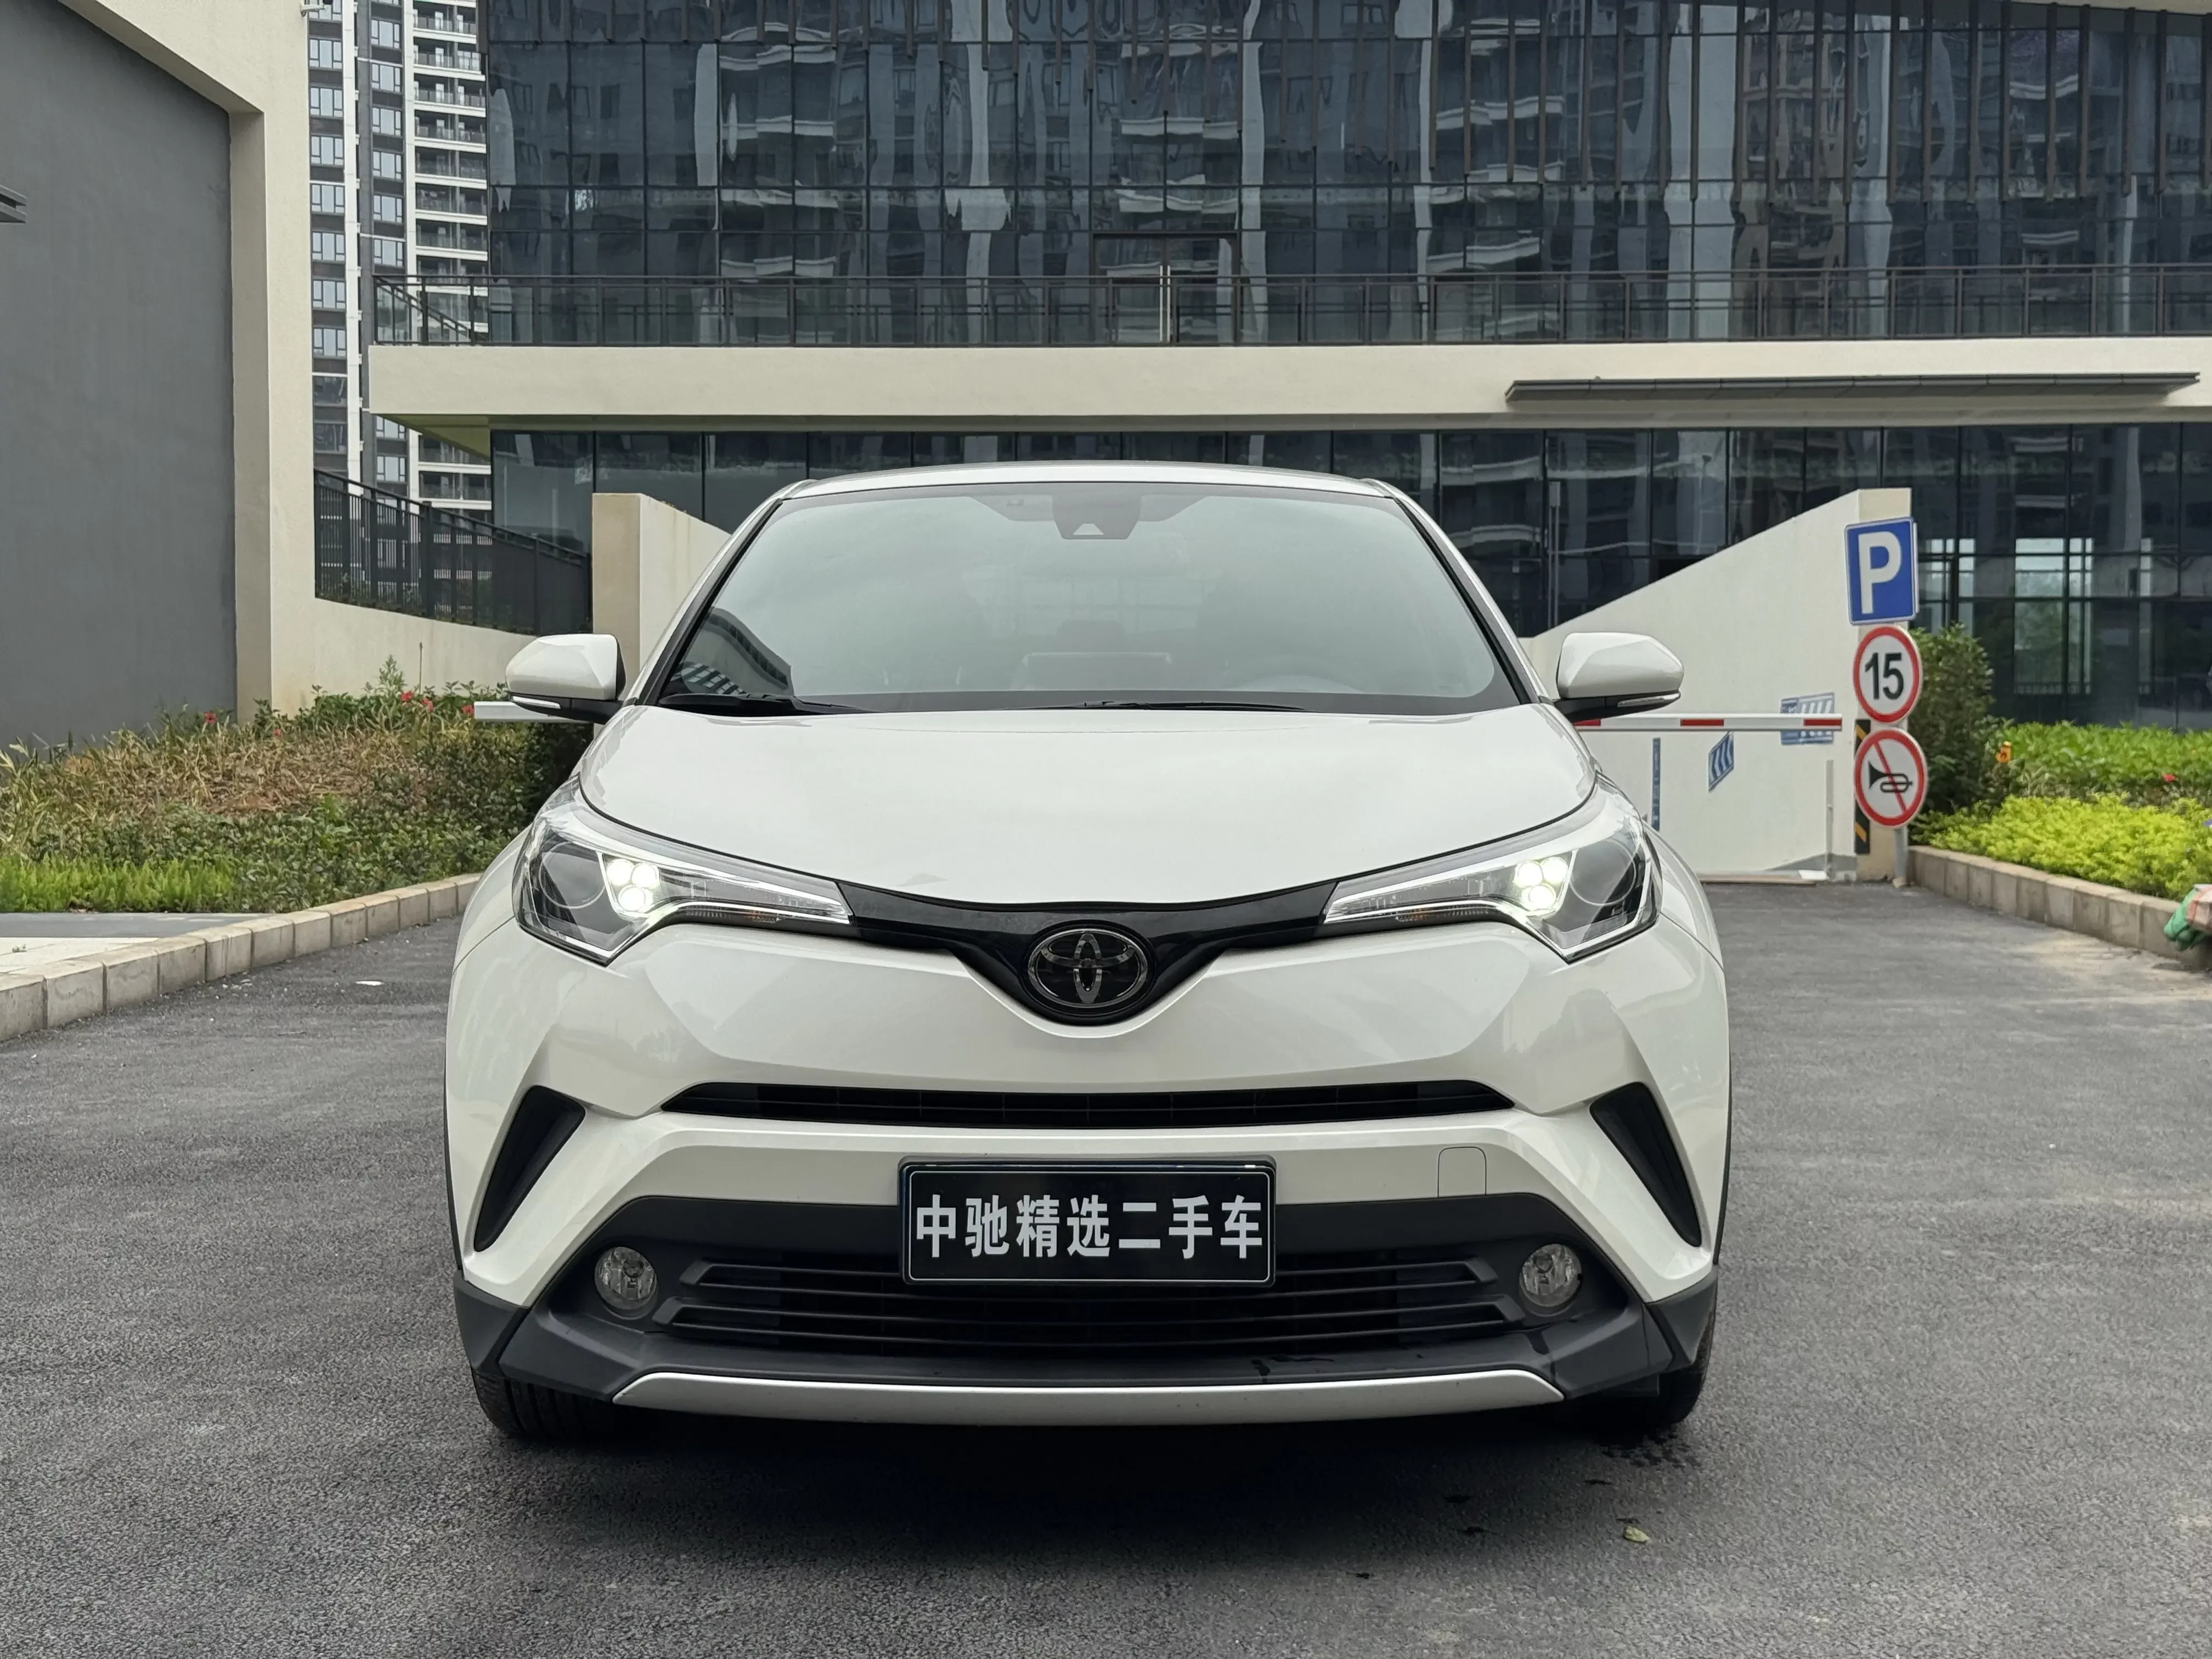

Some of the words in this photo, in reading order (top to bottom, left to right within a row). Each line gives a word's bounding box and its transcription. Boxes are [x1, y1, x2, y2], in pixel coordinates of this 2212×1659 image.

[1858, 531, 1901, 614] P
[1865, 652, 1904, 700] 15
[916, 1194, 1262, 1259] 中驰精选二手车
